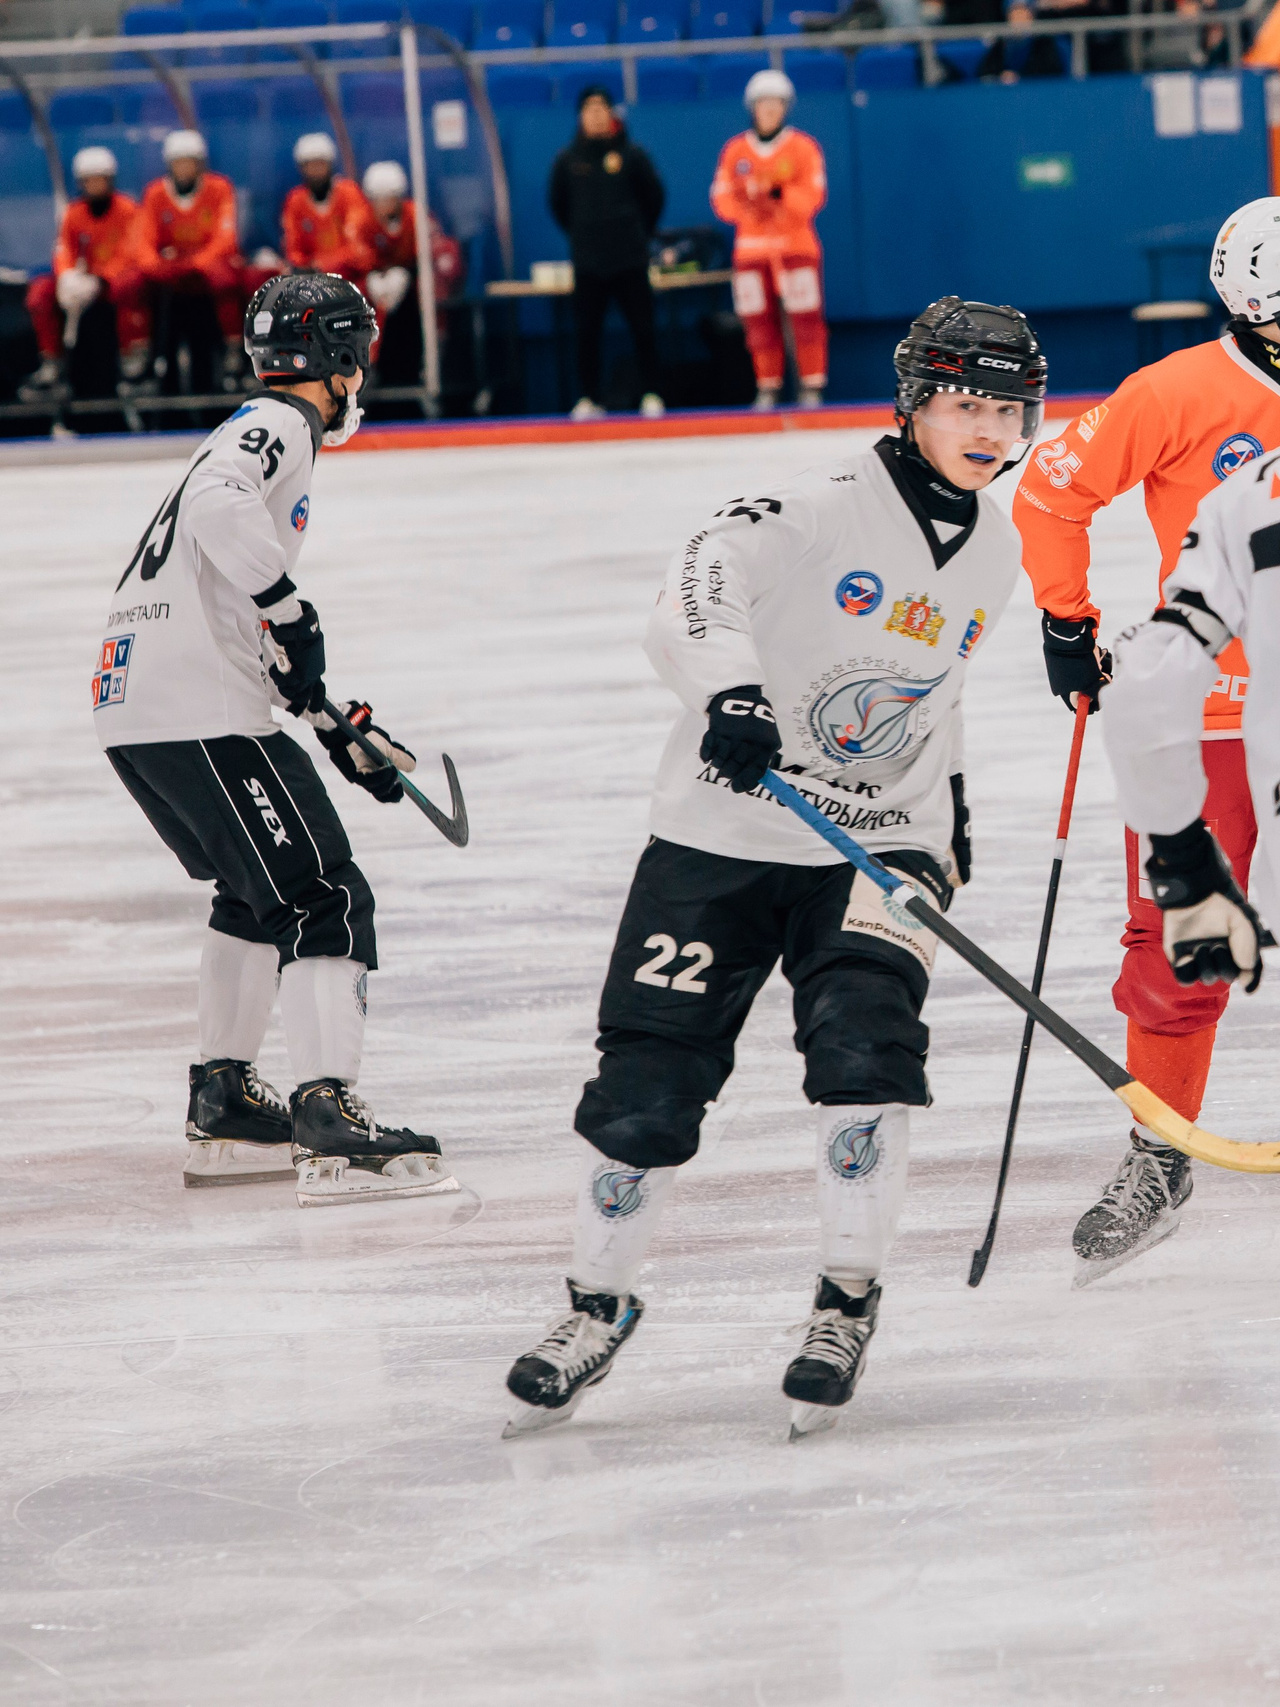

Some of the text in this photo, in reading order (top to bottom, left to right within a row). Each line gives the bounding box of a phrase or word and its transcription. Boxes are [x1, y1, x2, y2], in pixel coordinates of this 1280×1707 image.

[977, 356, 1022, 372] CCM
[238, 427, 286, 481] 95
[1035, 440, 1083, 490] 25
[1018, 484, 1053, 514] АКАДЕМИЯ
[721, 699, 776, 724] CC
[242, 777, 292, 848] STEX
[633, 932, 714, 994] 22
